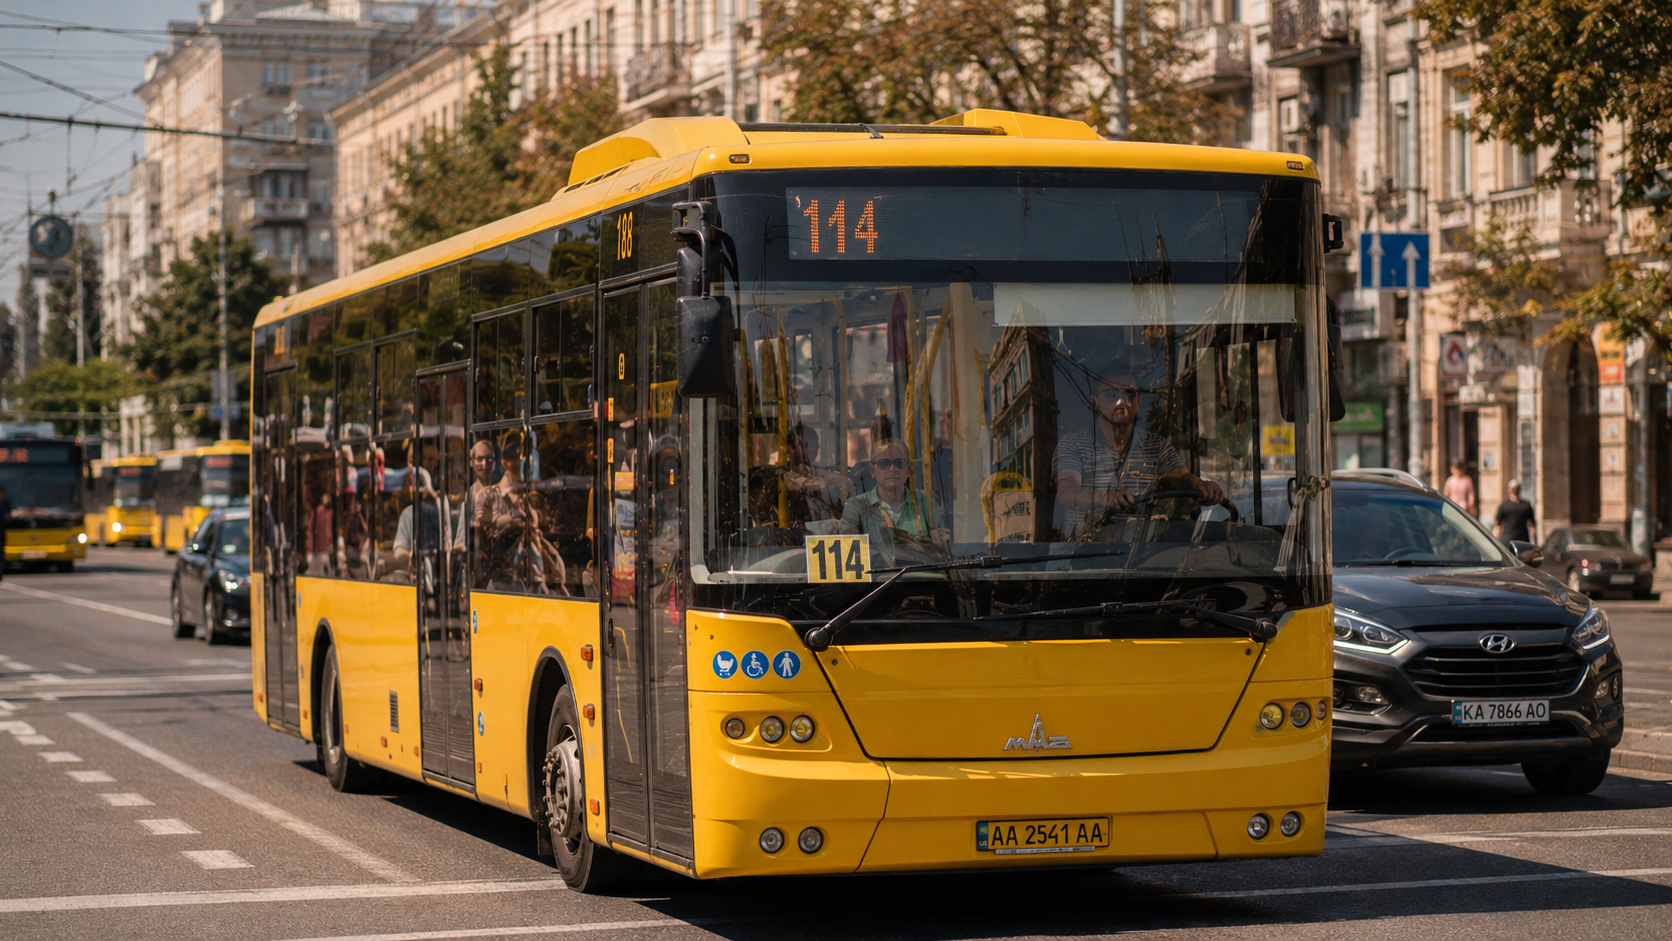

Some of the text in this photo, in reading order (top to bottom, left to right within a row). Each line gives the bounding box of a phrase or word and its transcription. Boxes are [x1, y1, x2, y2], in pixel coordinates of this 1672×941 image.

[617, 211, 633, 260] 188
[803, 200, 878, 253] 114
[812, 540, 865, 580] 114
[1463, 702, 1546, 720] KA 7866 AO
[991, 822, 1103, 846] AA 2541 AA
